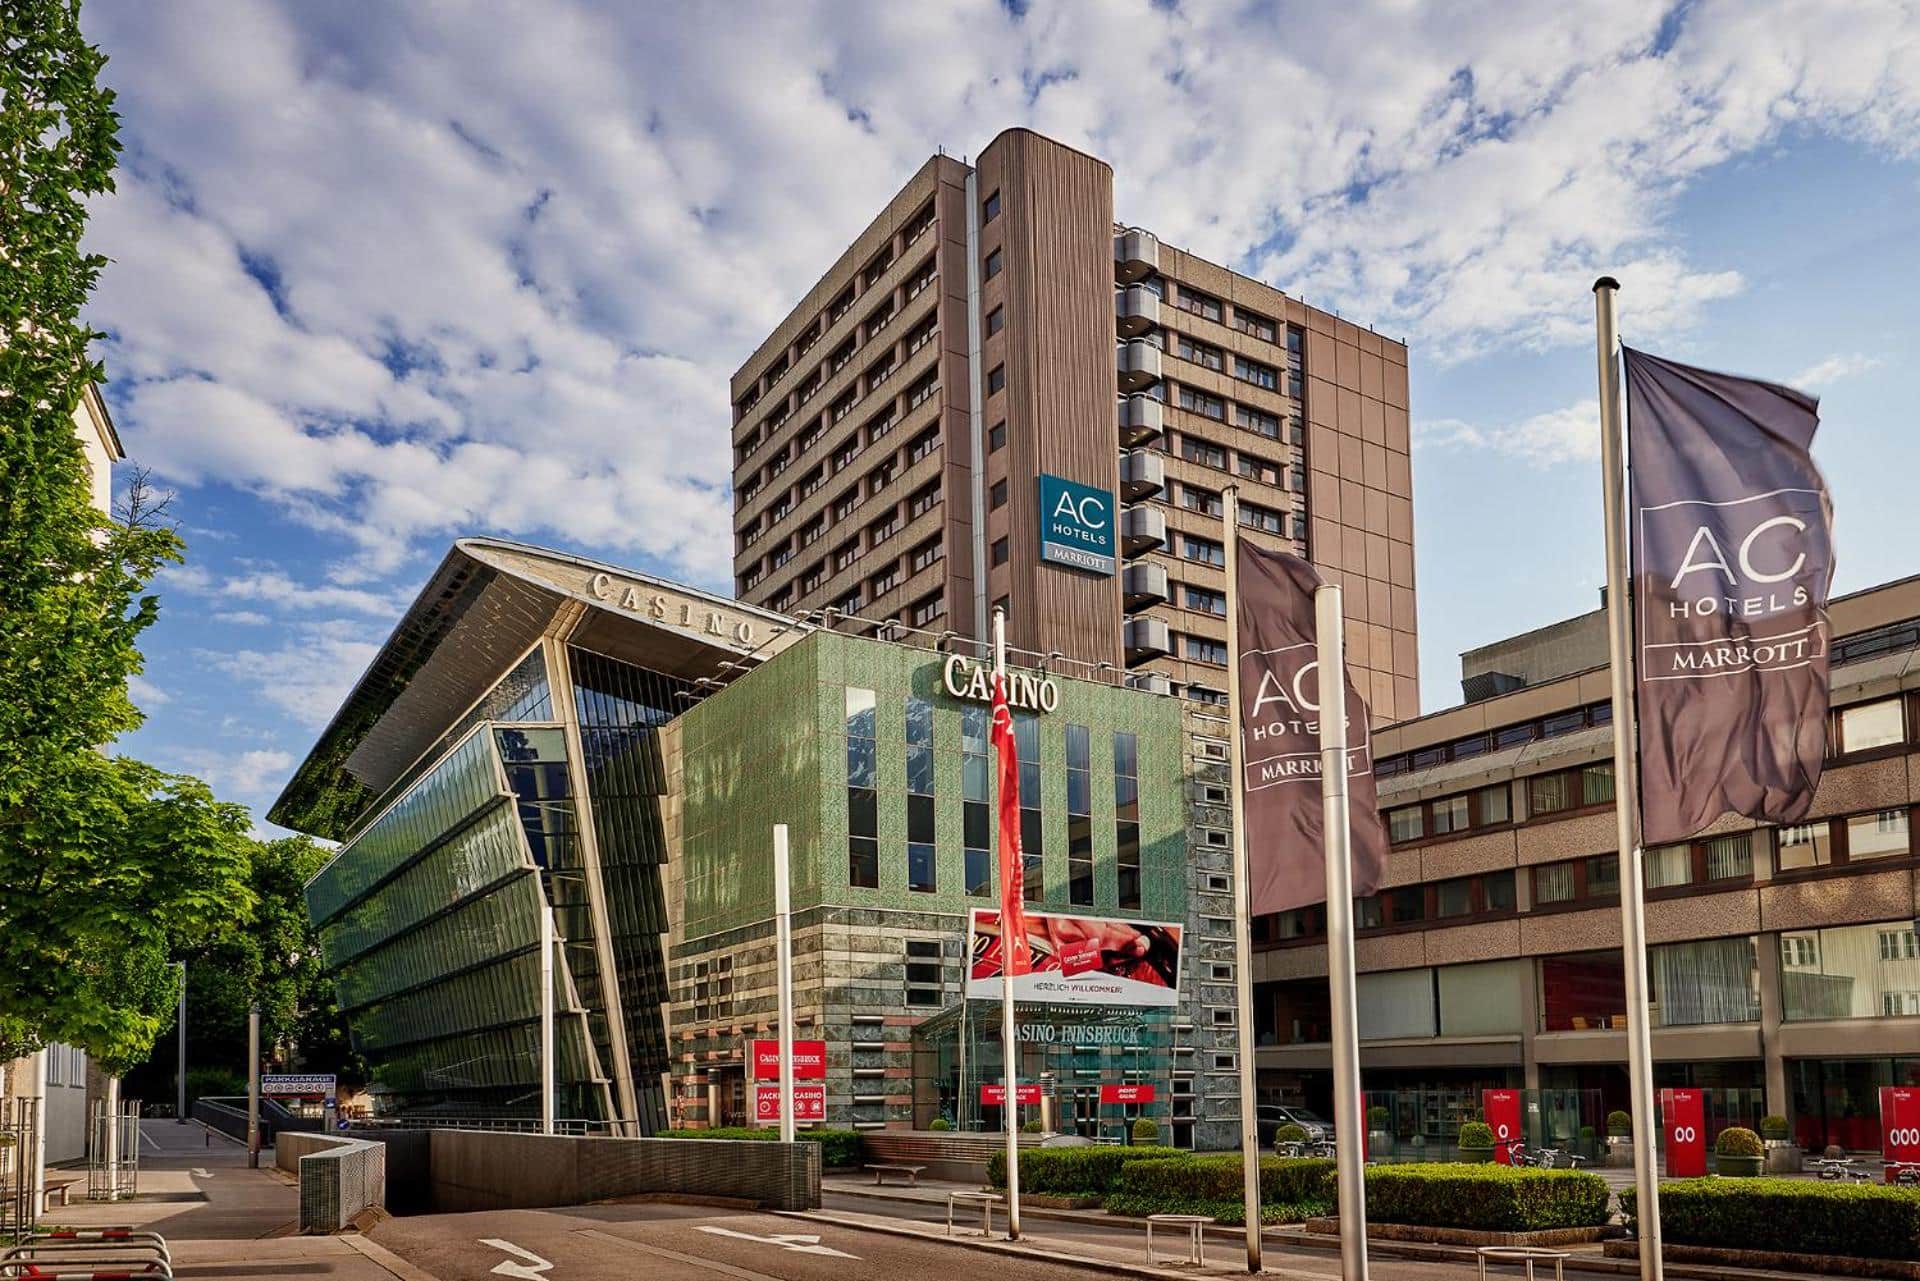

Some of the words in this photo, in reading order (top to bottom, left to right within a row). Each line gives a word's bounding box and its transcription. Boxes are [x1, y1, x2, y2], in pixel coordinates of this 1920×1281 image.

[1053, 490, 1105, 529] AC
[1053, 523, 1107, 545] HOTELS
[1054, 549, 1107, 569] MARRIOTT
[1669, 516, 1806, 589] AC
[591, 573, 753, 645] CASINO
[1670, 586, 1808, 618] HOTELS
[1672, 637, 1808, 671] MARROTT
[1262, 755, 1356, 781] MARRIT
[1033, 982, 1070, 992] HERZLICH
[1061, 1024, 1140, 1044] INNSBRUCK
